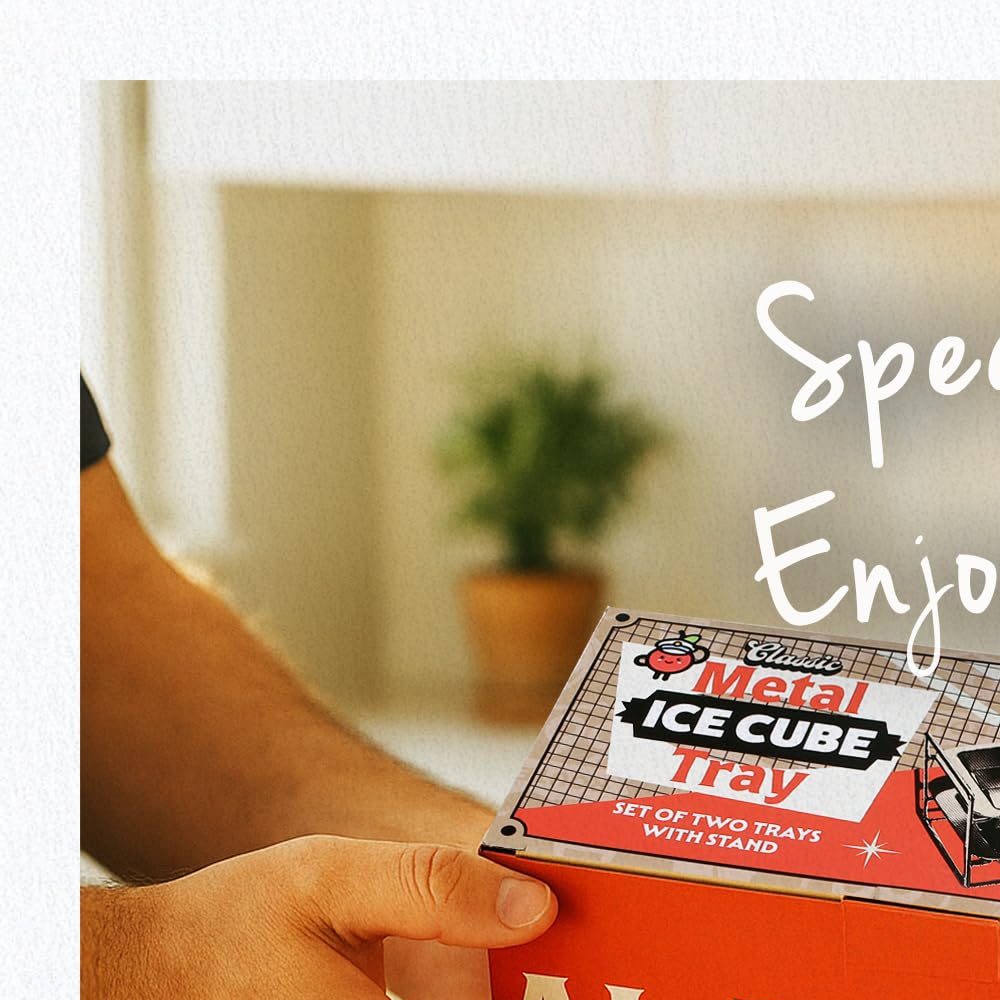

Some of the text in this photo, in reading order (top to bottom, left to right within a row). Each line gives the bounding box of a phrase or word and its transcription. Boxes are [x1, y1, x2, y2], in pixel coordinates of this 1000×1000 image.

[745, 640, 843, 675] Classic
[691, 661, 870, 714] Metal
[641, 700, 879, 759] ICE CUBE
[671, 748, 810, 805] Tray
[612, 803, 822, 843] SET OF TWO TRAYS
[643, 823, 778, 854] WITH STAND
